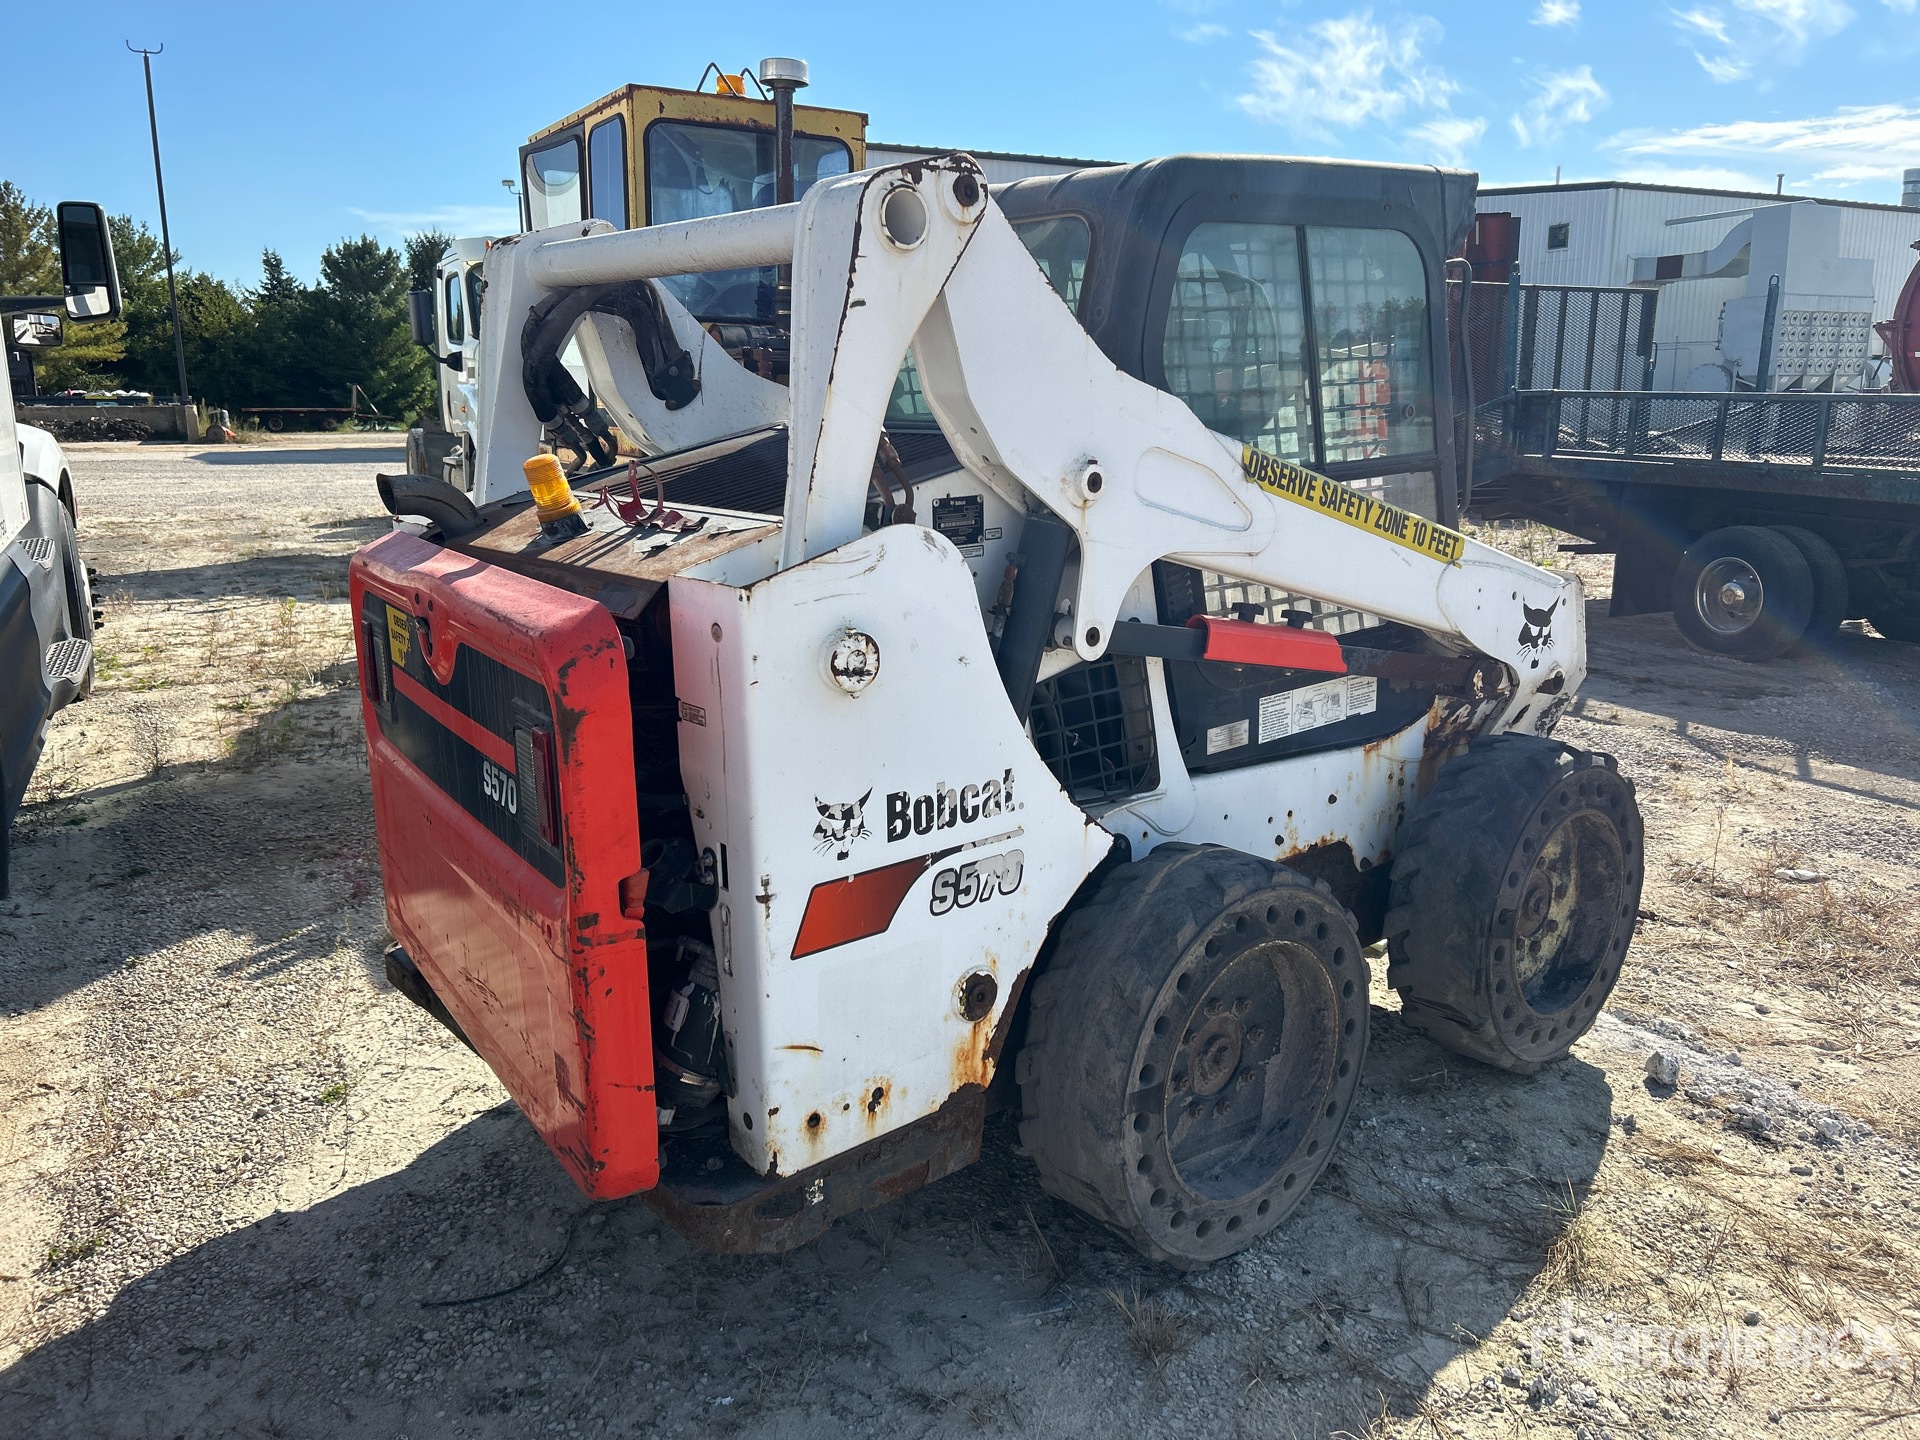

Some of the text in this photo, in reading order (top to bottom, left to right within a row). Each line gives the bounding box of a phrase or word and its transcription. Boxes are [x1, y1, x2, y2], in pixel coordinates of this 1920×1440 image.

[1249, 450, 1459, 560] OBSERVE SAFETY ZONE 10 FEET
[483, 760, 517, 815] S570
[930, 849, 1025, 917] S570
